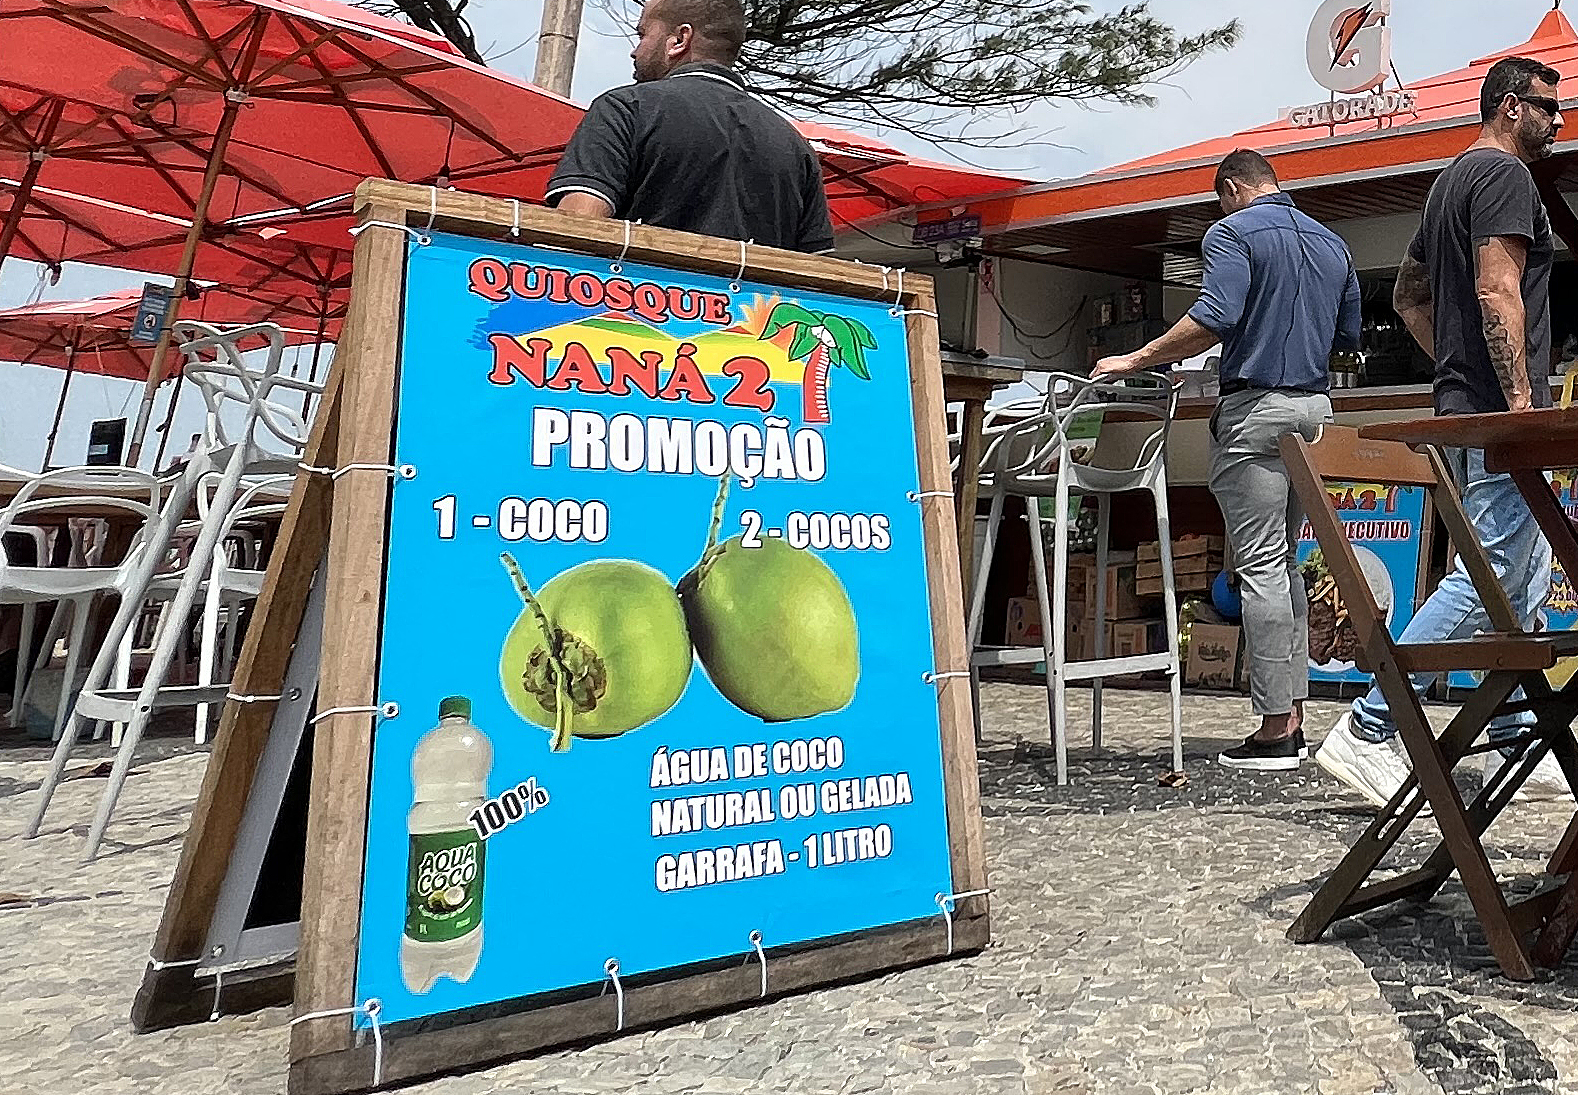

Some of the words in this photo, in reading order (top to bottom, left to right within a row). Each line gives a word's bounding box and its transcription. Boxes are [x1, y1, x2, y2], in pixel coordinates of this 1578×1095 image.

[1289, 90, 1418, 126] GATORADE
[468, 258, 733, 326] QUIOSQUE
[488, 335, 713, 407] NANÁ
[722, 356, 775, 412] 2
[531, 408, 827, 488] PROMOÇÃO
[432, 494, 457, 541] 1
[498, 497, 609, 544] COCO
[739, 512, 763, 549] 2
[788, 510, 892, 551] COCOS
[650, 744, 729, 788] ÁGUA
[734, 740, 768, 779] DE
[772, 735, 844, 775] COCO
[467, 776, 549, 840] 100%
[650, 788, 776, 838] NATURAL
[779, 779, 816, 820] OU
[820, 772, 913, 814] GELADA
[418, 842, 477, 875] AQUA
[418, 862, 477, 896] COCO
[655, 837, 785, 893] GARRAFA
[804, 833, 820, 870] 1
[822, 823, 893, 867] LITRO
